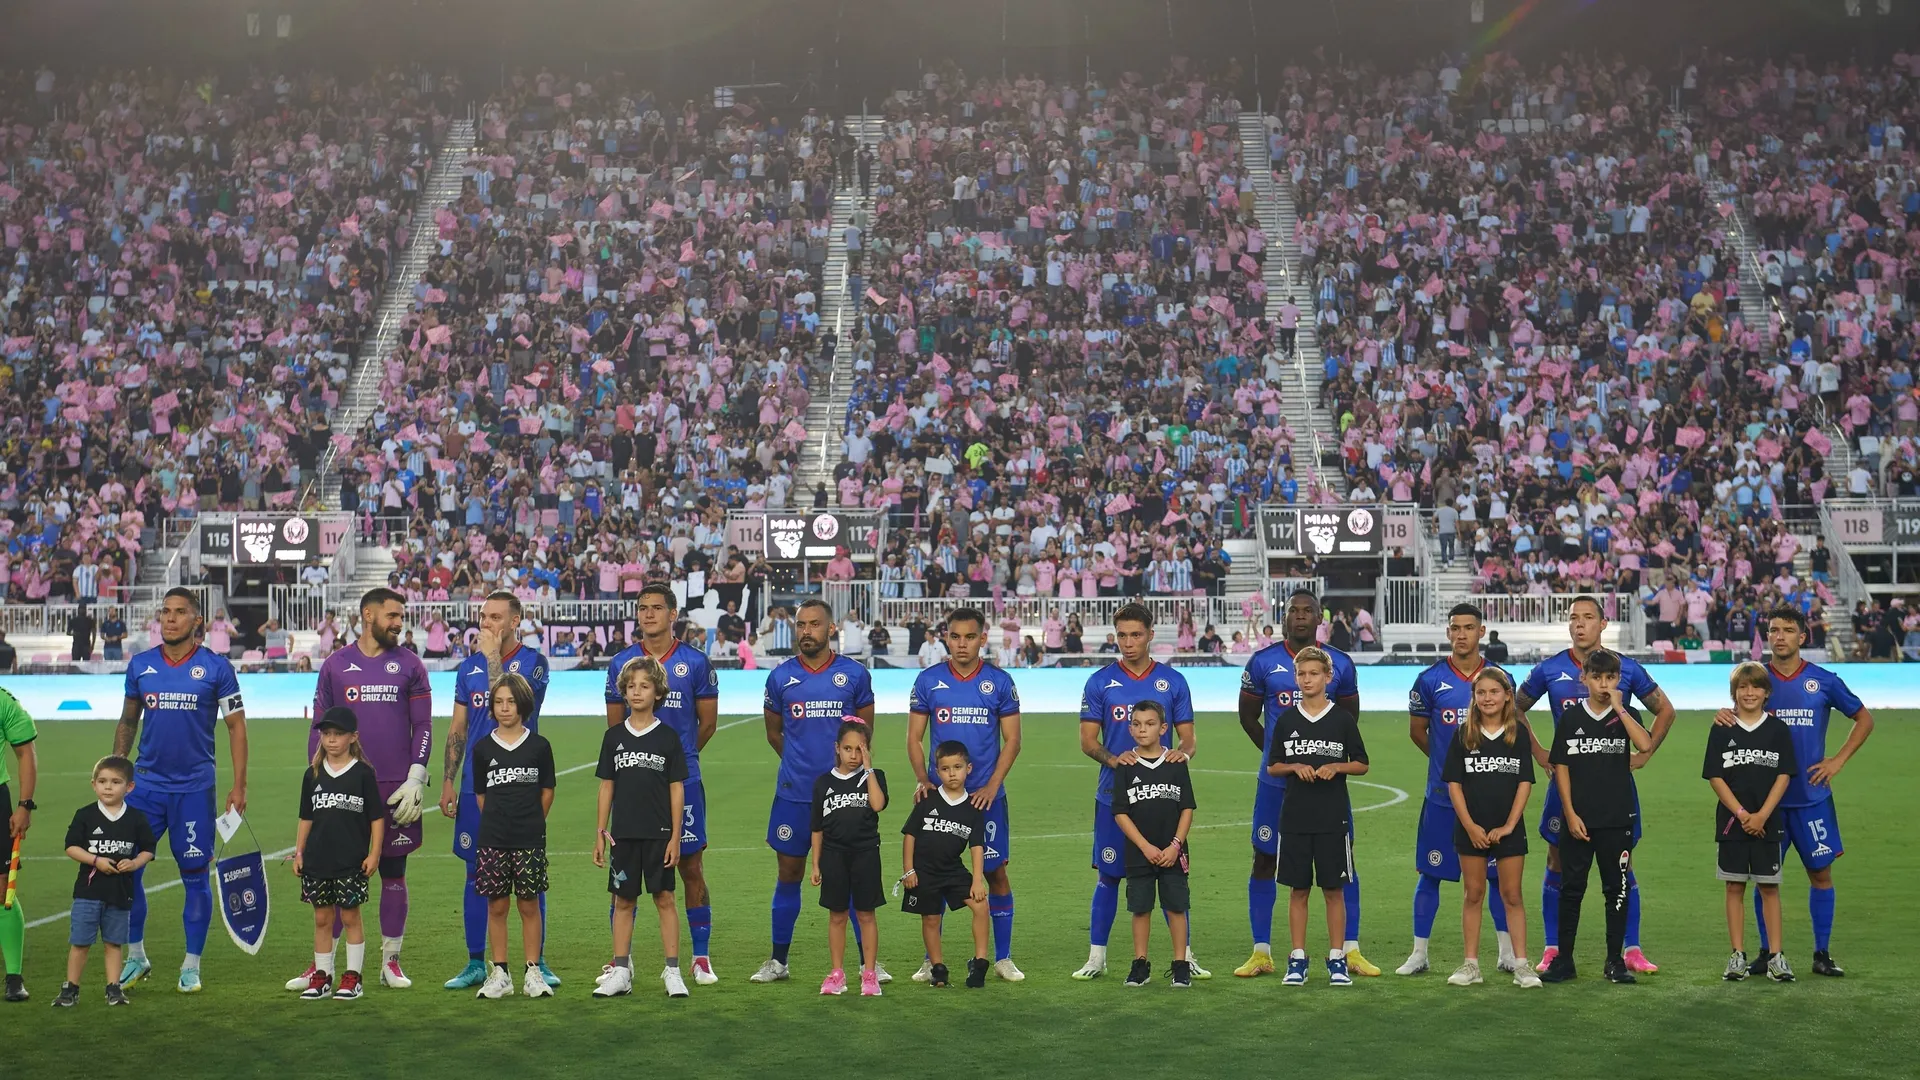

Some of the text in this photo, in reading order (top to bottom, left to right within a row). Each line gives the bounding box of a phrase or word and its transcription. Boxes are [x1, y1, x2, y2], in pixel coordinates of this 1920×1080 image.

[1270, 523, 1294, 539] 117
[1382, 524, 1406, 538] 118
[1844, 519, 1869, 534] 118
[1896, 518, 1920, 534] 119
[208, 532, 230, 547] 115
[739, 528, 762, 541] 116
[361, 685, 398, 693] CEMENTO
[159, 692, 198, 701] CEMENTO
[361, 694, 397, 702] CRUZ AZUL
[159, 702, 197, 710] CRUZ AZUL
[665, 700, 682, 708] AZUL
[952, 707, 988, 715] CEMENTO
[1776, 709, 1813, 717] CEMENTO
[972, 716, 989, 724] AZUL
[1797, 718, 1814, 726] AZUL
[419, 730, 430, 758] PIRMA
[1295, 740, 1343, 751] LEAGUES
[1580, 738, 1625, 747] LEAGUES
[618, 752, 666, 765] LEAGUES
[1734, 749, 1779, 760] LEAGUES
[619, 760, 638, 768] CUP
[1474, 757, 1520, 767] LEAGUES
[494, 768, 538, 777] LEAGUES
[494, 775, 516, 784] CUP
[1136, 784, 1181, 795] LEAGUES
[316, 793, 364, 806] LEAGUES
[829, 793, 869, 804] LEAGUE
[1137, 791, 1160, 800] CUP
[831, 800, 851, 810] CUP
[185, 821, 196, 843] 3
[935, 819, 972, 835] LEAGUES
[1808, 819, 1828, 842] 15
[1812, 849, 1832, 857] PIRMA
